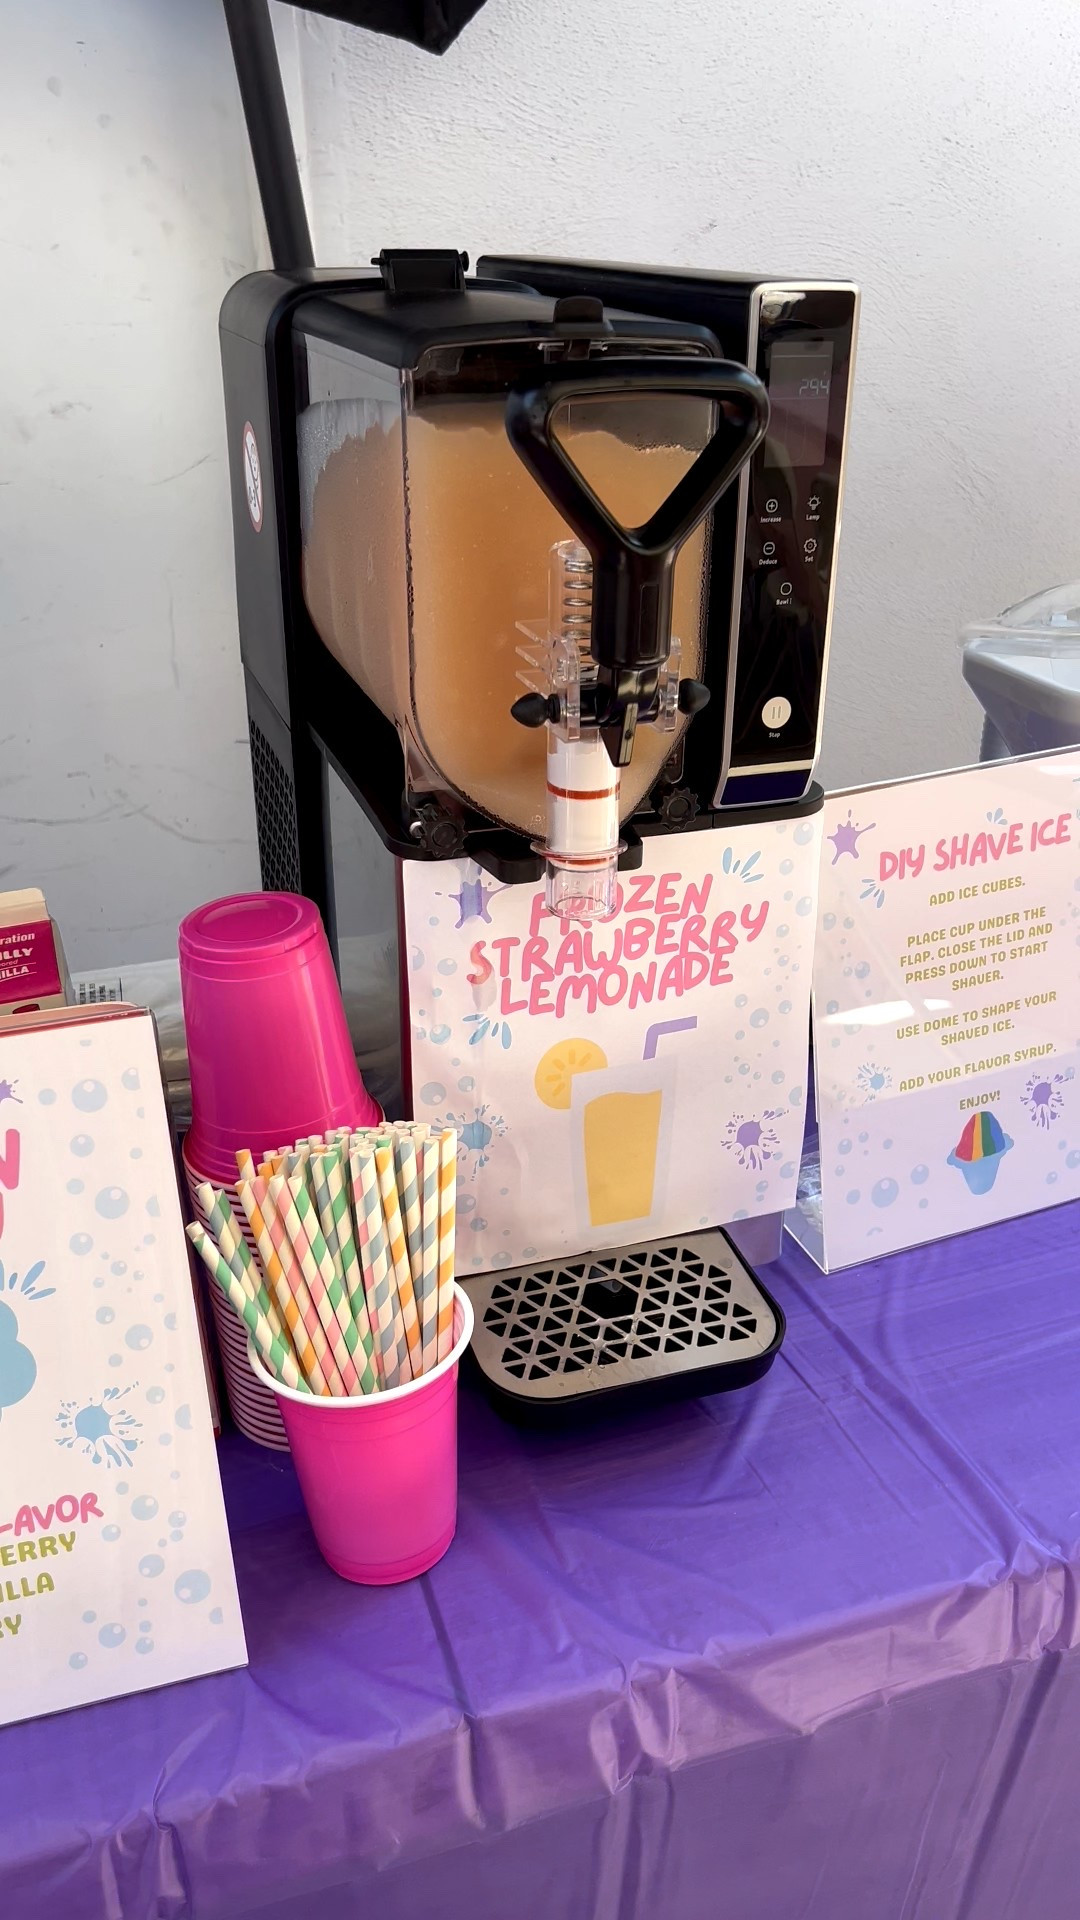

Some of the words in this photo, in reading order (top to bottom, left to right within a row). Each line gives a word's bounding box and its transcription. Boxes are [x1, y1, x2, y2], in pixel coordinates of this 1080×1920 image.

[879, 844, 926, 881] DIY
[933, 822, 1024, 871] SHAVE
[1030, 813, 1072, 852] ICE
[929, 890, 955, 906] ADD
[958, 885, 978, 900] ICE
[982, 876, 1026, 895] CUBES.
[466, 900, 770, 985] STRAWBERRY
[900, 950, 934, 967] FLAP.
[937, 939, 976, 959] CLOSE
[980, 933, 1003, 949] THE
[1006, 929, 1025, 944] LID
[1028, 922, 1053, 938] AND
[907, 928, 947, 947] PLACE
[950, 922, 975, 938] CUP
[978, 912, 1020, 932] UNDER
[1023, 906, 1047, 921] THE
[0, 958, 19, 967] ored
[0, 965, 29, 980] ILLA
[905, 965, 946, 984] PRESS
[949, 957, 987, 974] DOWN
[991, 950, 1006, 963] TO
[1009, 940, 1049, 960] START
[952, 969, 1004, 991] SHAVER.
[500, 951, 734, 1019] LEMONADE
[896, 1024, 920, 1040] USE
[924, 1014, 960, 1033] DOME
[963, 1010, 978, 1023] TO
[981, 999, 1021, 1018] SHAPE
[1024, 990, 1057, 1009] YOUR
[941, 1024, 990, 1046] SHAVED
[993, 1018, 1015, 1033] ICE.
[899, 1075, 925, 1092] ADD
[928, 1066, 961, 1085] YOUR
[964, 1053, 1011, 1075] FLAVOR
[1014, 1042, 1057, 1062] SYRUP.
[959, 1090, 1001, 1111] ENJOY!
